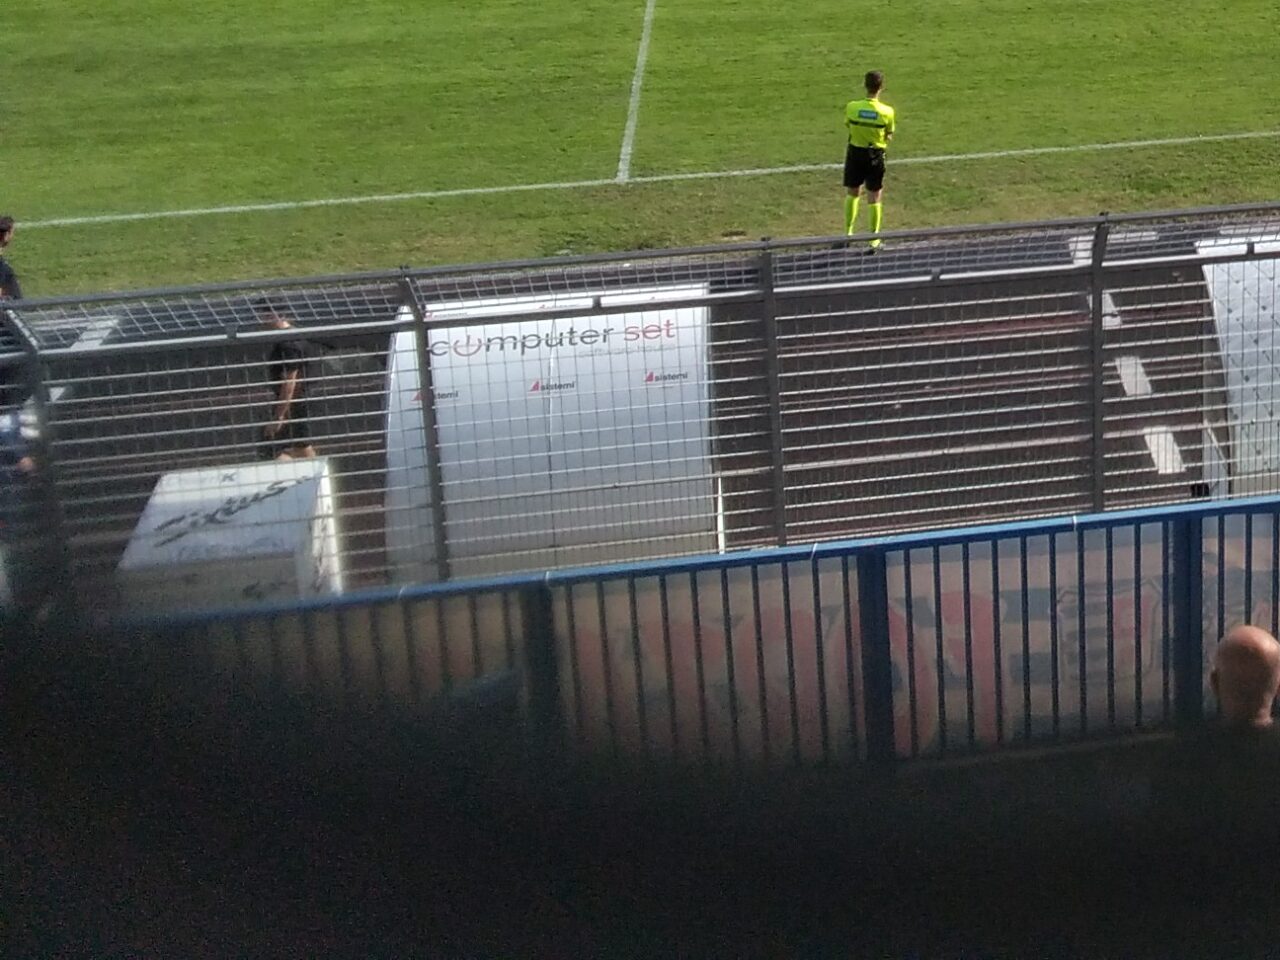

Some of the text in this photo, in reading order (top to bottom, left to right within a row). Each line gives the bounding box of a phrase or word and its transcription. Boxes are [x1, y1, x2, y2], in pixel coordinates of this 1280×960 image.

[430, 326, 615, 358] computer
[624, 319, 676, 343] set
[655, 371, 689, 383] sistemi
[540, 381, 576, 392] sistemi
